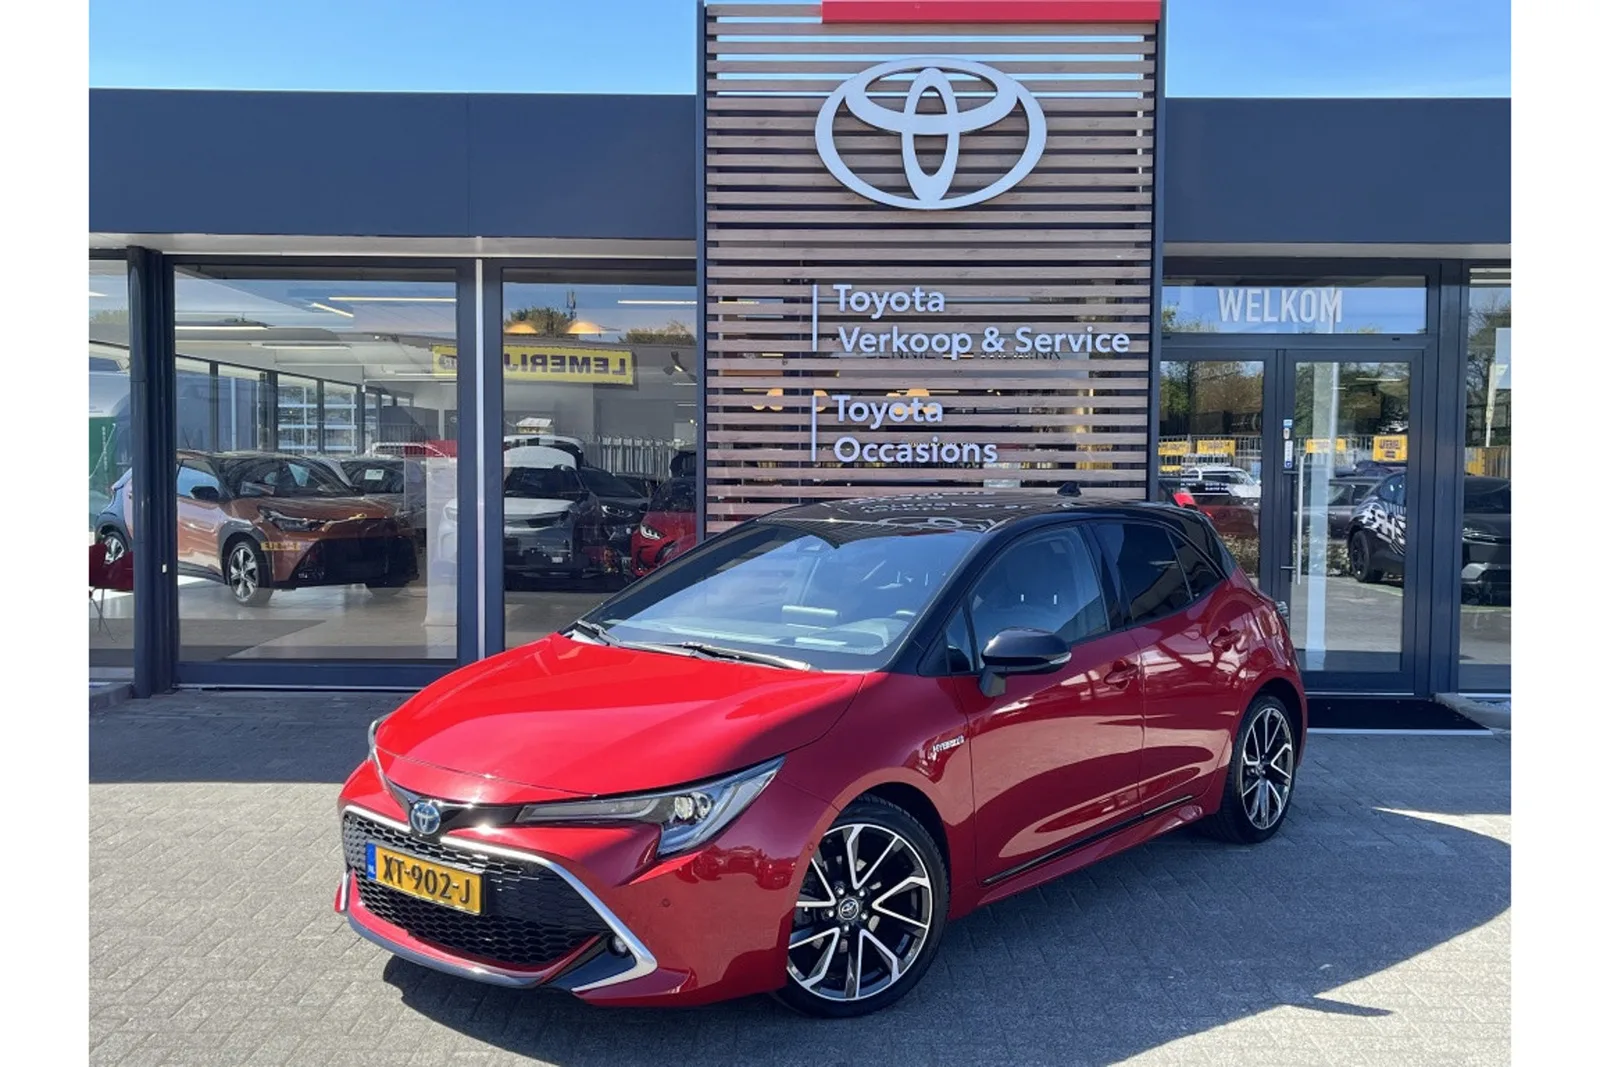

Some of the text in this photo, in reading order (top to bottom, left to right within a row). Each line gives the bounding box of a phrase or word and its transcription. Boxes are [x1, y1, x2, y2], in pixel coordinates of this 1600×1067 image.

[833, 284, 945, 319] Toyota
[1218, 288, 1343, 322] WELKOM
[839, 326, 1130, 359] Verkoop & Service
[832, 395, 943, 429] Toyota
[834, 436, 998, 463] Occasions
[383, 855, 470, 904] XT-902-J
